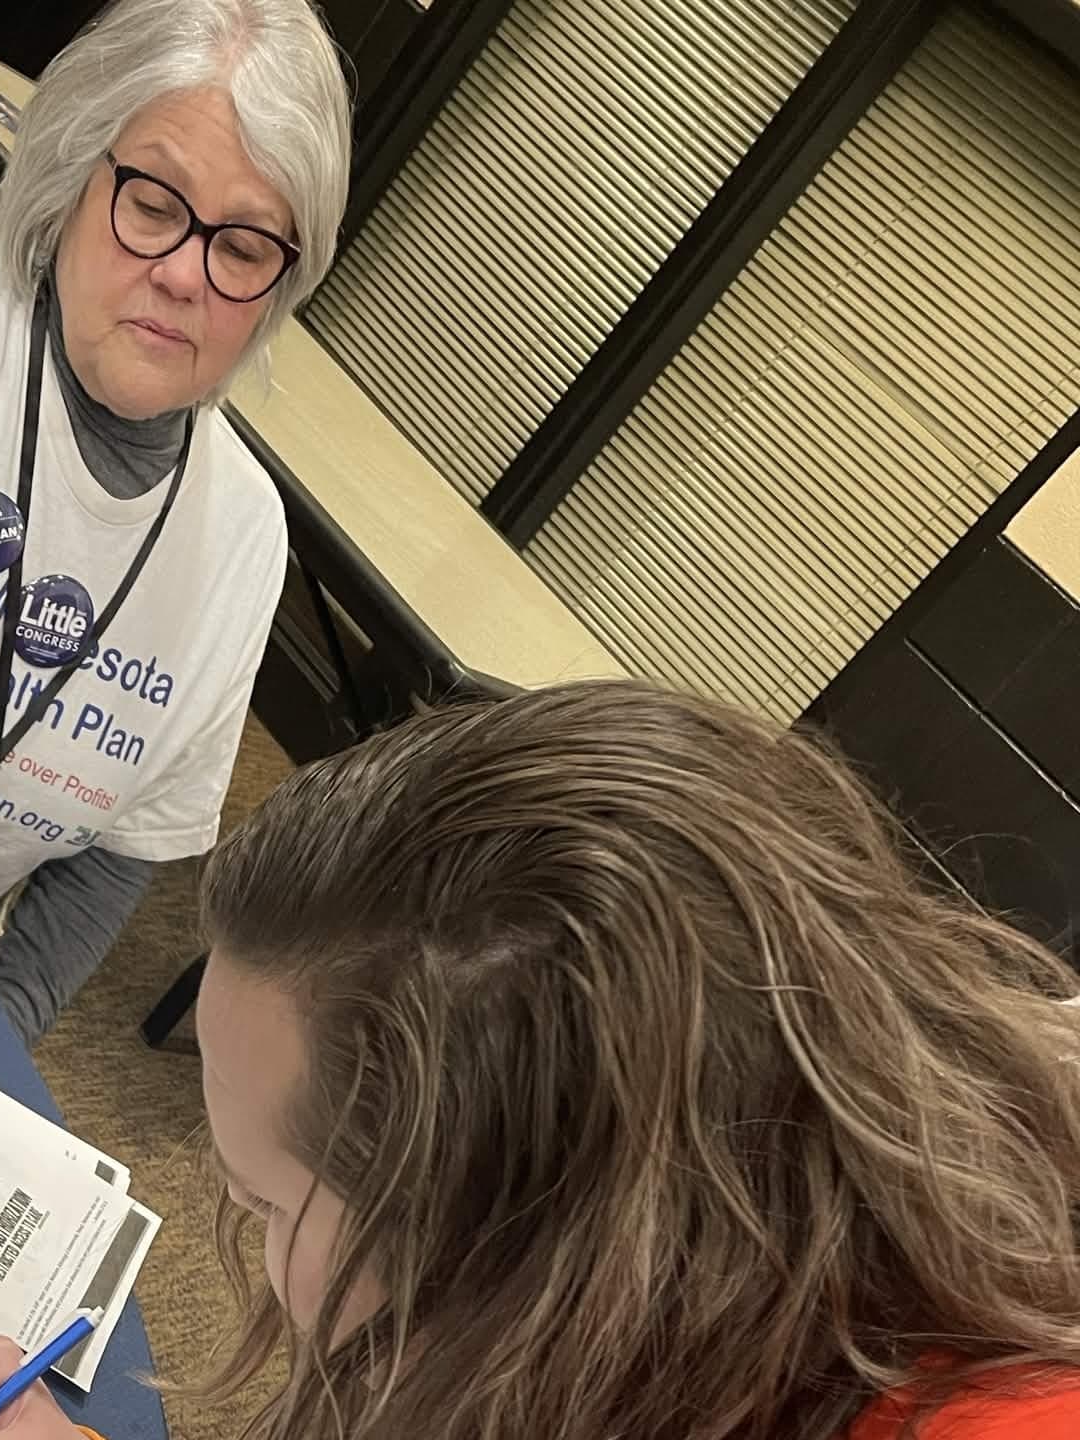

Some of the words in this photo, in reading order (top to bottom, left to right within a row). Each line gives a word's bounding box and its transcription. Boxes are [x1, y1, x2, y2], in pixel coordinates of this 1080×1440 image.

[21, 594, 87, 638] Little
[15, 626, 80, 652] CONGRESS
[71, 703, 145, 765] Plan
[19, 754, 62, 787] over
